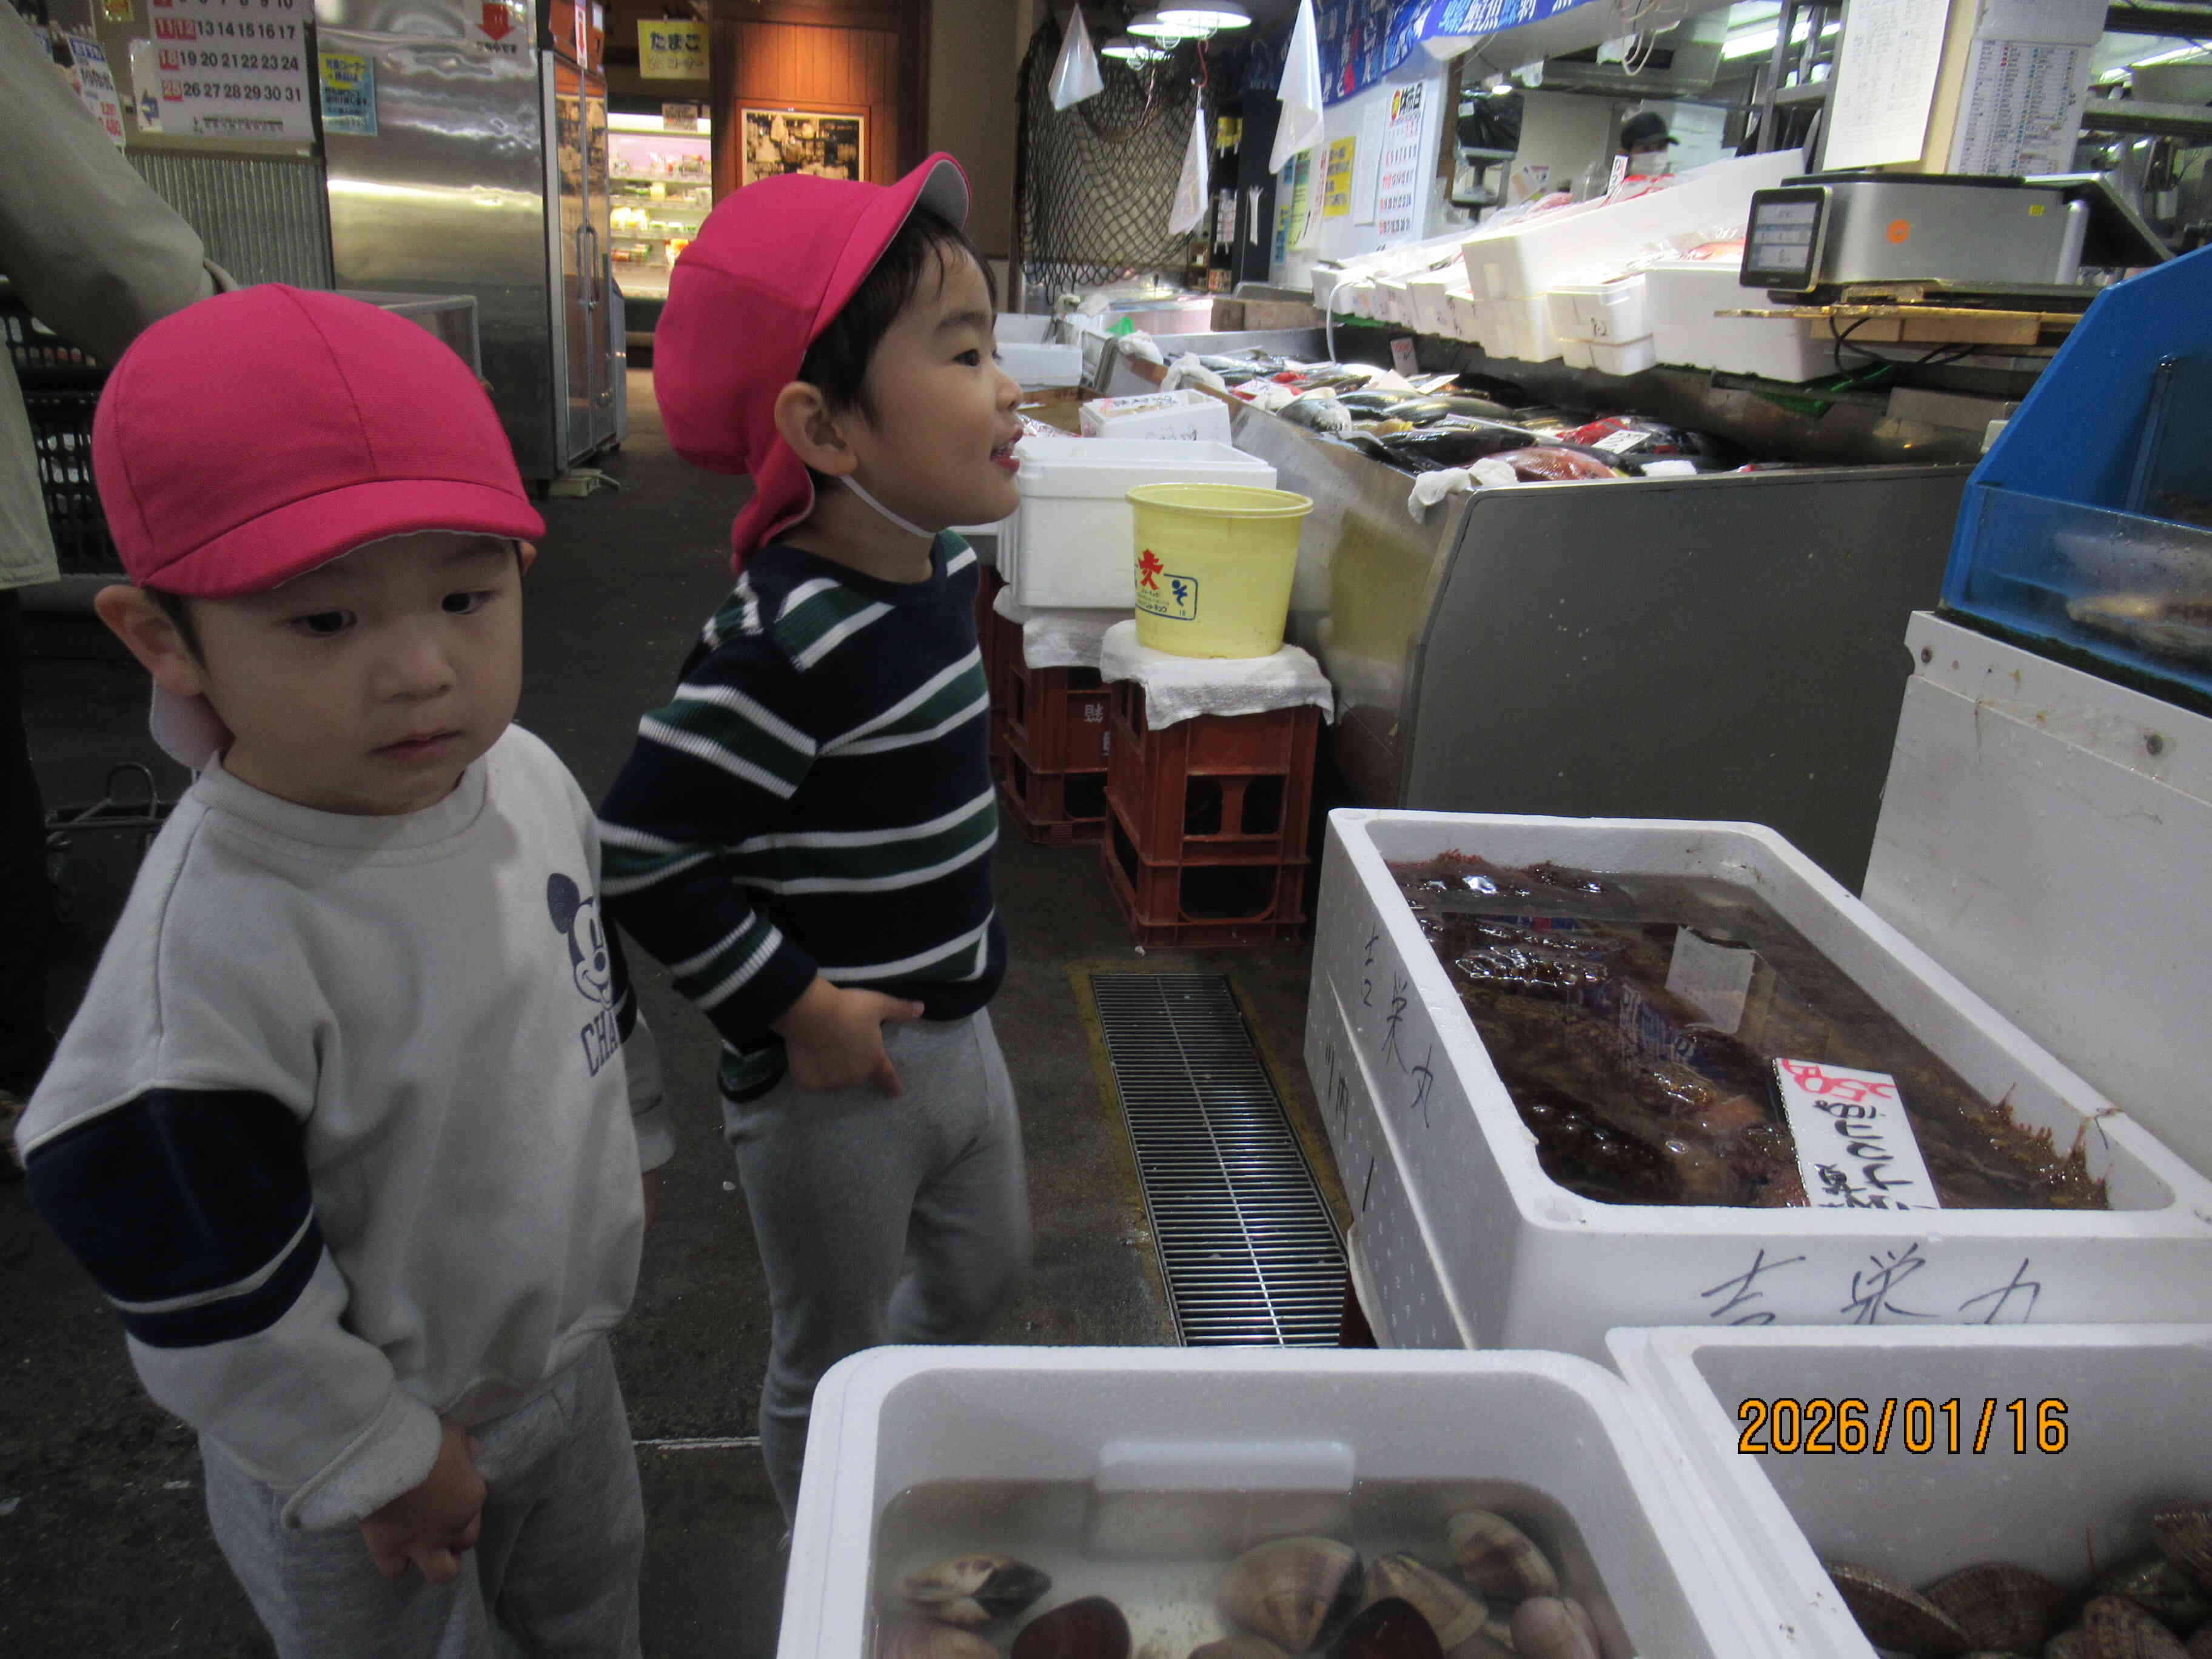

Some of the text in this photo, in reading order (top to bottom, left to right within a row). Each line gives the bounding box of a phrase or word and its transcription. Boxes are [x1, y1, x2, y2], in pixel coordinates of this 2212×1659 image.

[198, 20, 214, 36] 13
[218, 22, 235, 37] 14
[238, 22, 255, 38] 15
[258, 23, 275, 39] 16
[278, 24, 295, 39] 17
[649, 32, 700, 52] たまご
[181, 52, 196, 66] 19
[201, 53, 218, 67] 20
[221, 54, 238, 69] 21
[241, 55, 258, 69] 22
[261, 55, 278, 70] 23
[281, 56, 299, 70] 24
[183, 82, 201, 97] 26
[204, 84, 220, 98] 27
[224, 85, 241, 99] 28
[244, 85, 261, 100] 29
[264, 86, 281, 101] 30
[286, 87, 301, 102] 31
